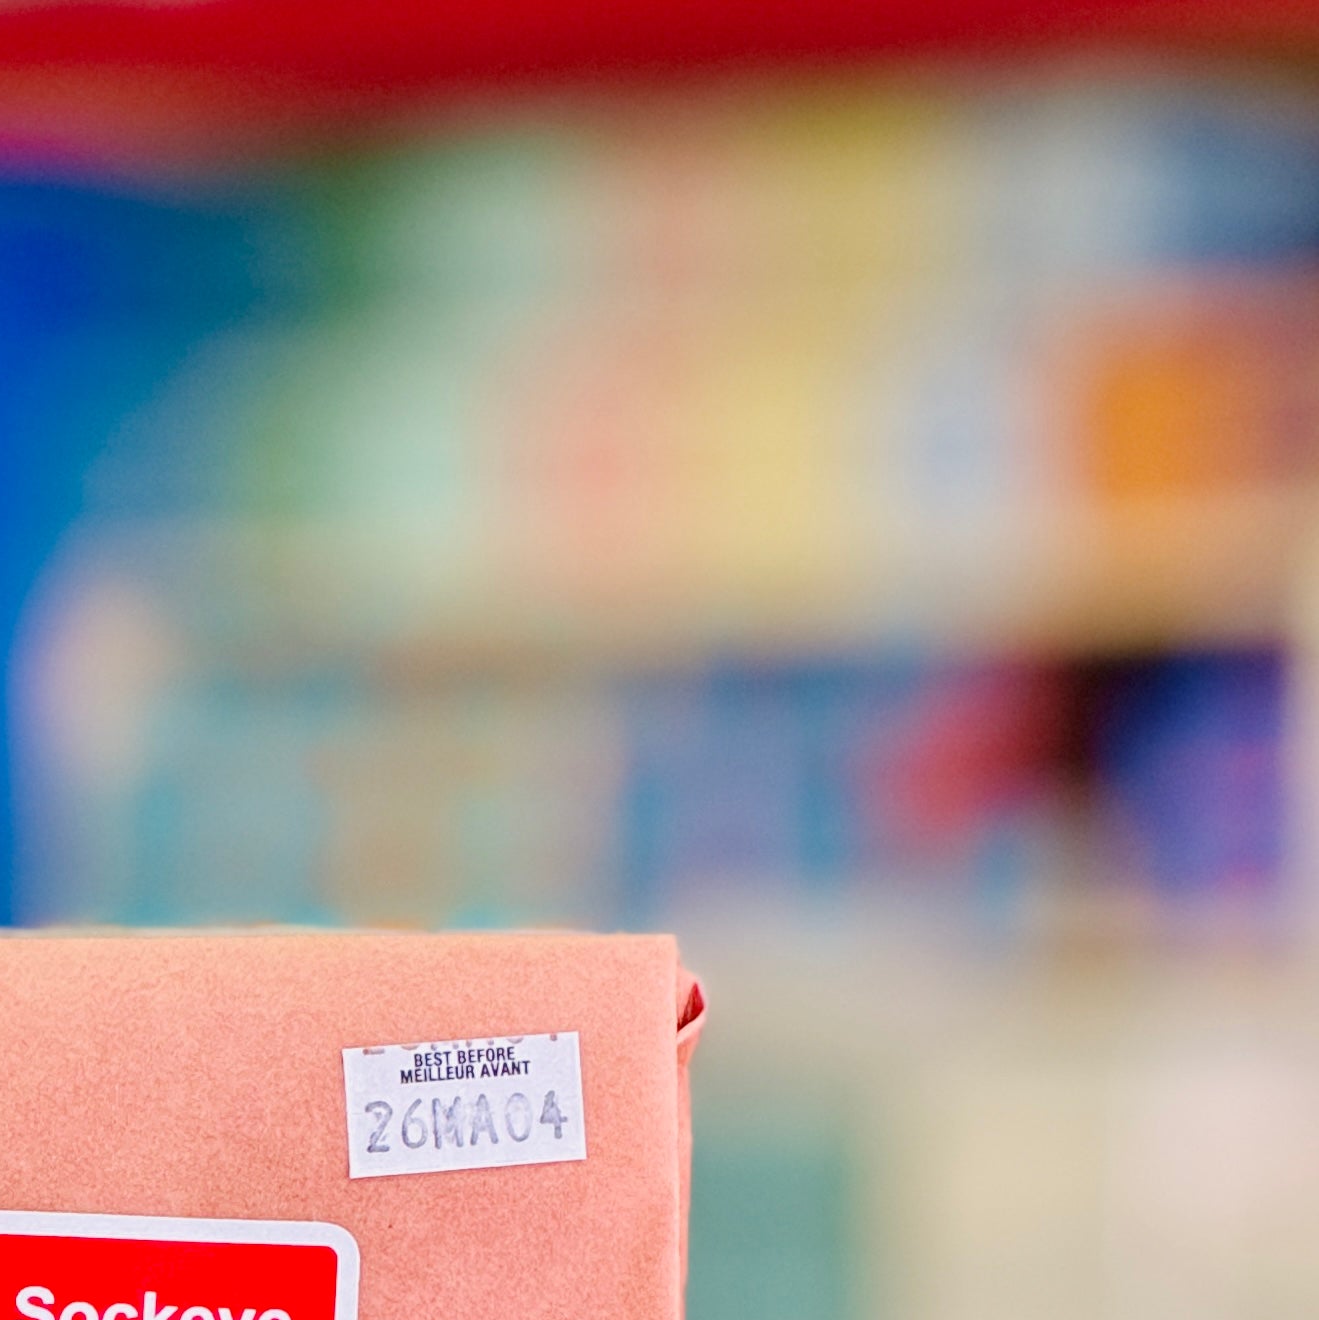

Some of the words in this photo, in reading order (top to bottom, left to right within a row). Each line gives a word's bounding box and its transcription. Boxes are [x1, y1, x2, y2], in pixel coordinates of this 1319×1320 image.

[414, 1051, 451, 1067] BEST
[458, 1046, 515, 1064] BEFORE
[400, 1065, 475, 1084] MEILLEUR
[480, 1061, 531, 1079] AVANT
[365, 1090, 568, 1153] 26MA04
